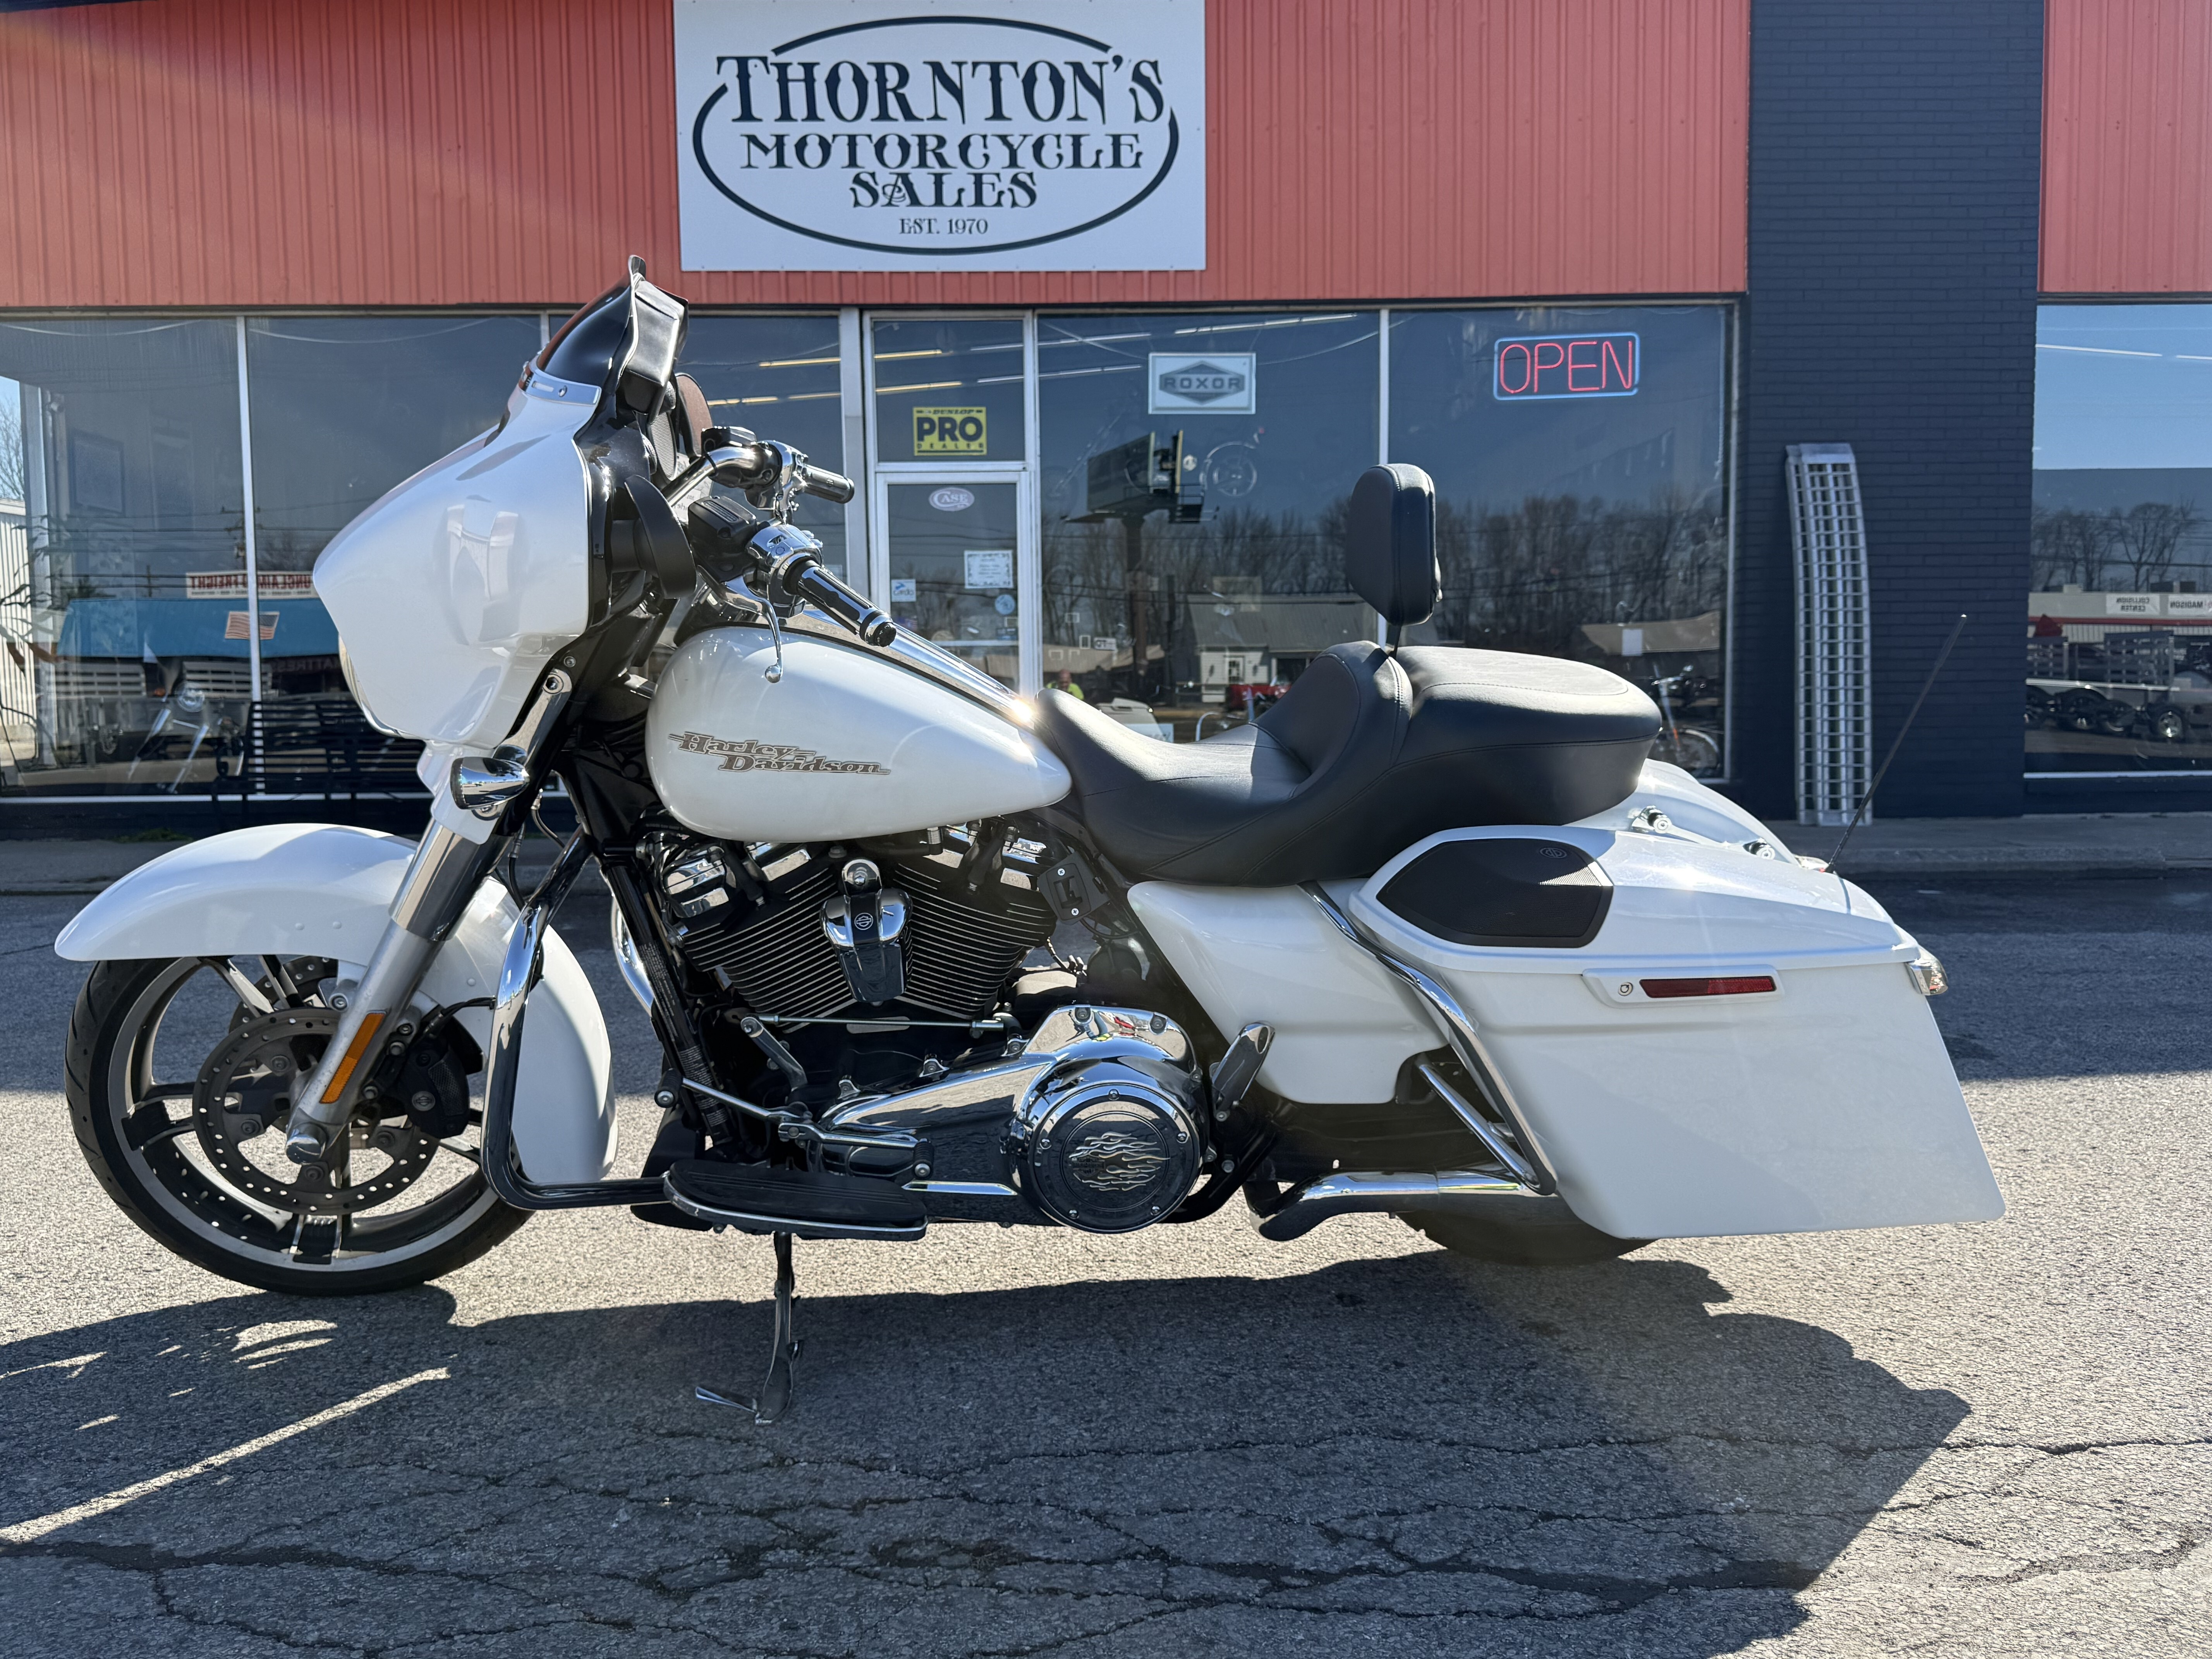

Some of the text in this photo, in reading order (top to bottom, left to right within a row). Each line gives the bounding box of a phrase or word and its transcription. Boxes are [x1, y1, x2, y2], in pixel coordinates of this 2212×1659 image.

[716, 55, 1163, 124] THORNTON'S
[740, 133, 1143, 169] MOTORCYCLE
[850, 172, 1037, 208] SALES
[899, 218, 988, 235] EST. 1970
[1500, 341, 1633, 394] OPEN
[1164, 377, 1240, 389] ROXOR
[917, 416, 983, 441] PRO
[718, 754, 891, 775] Davidson
